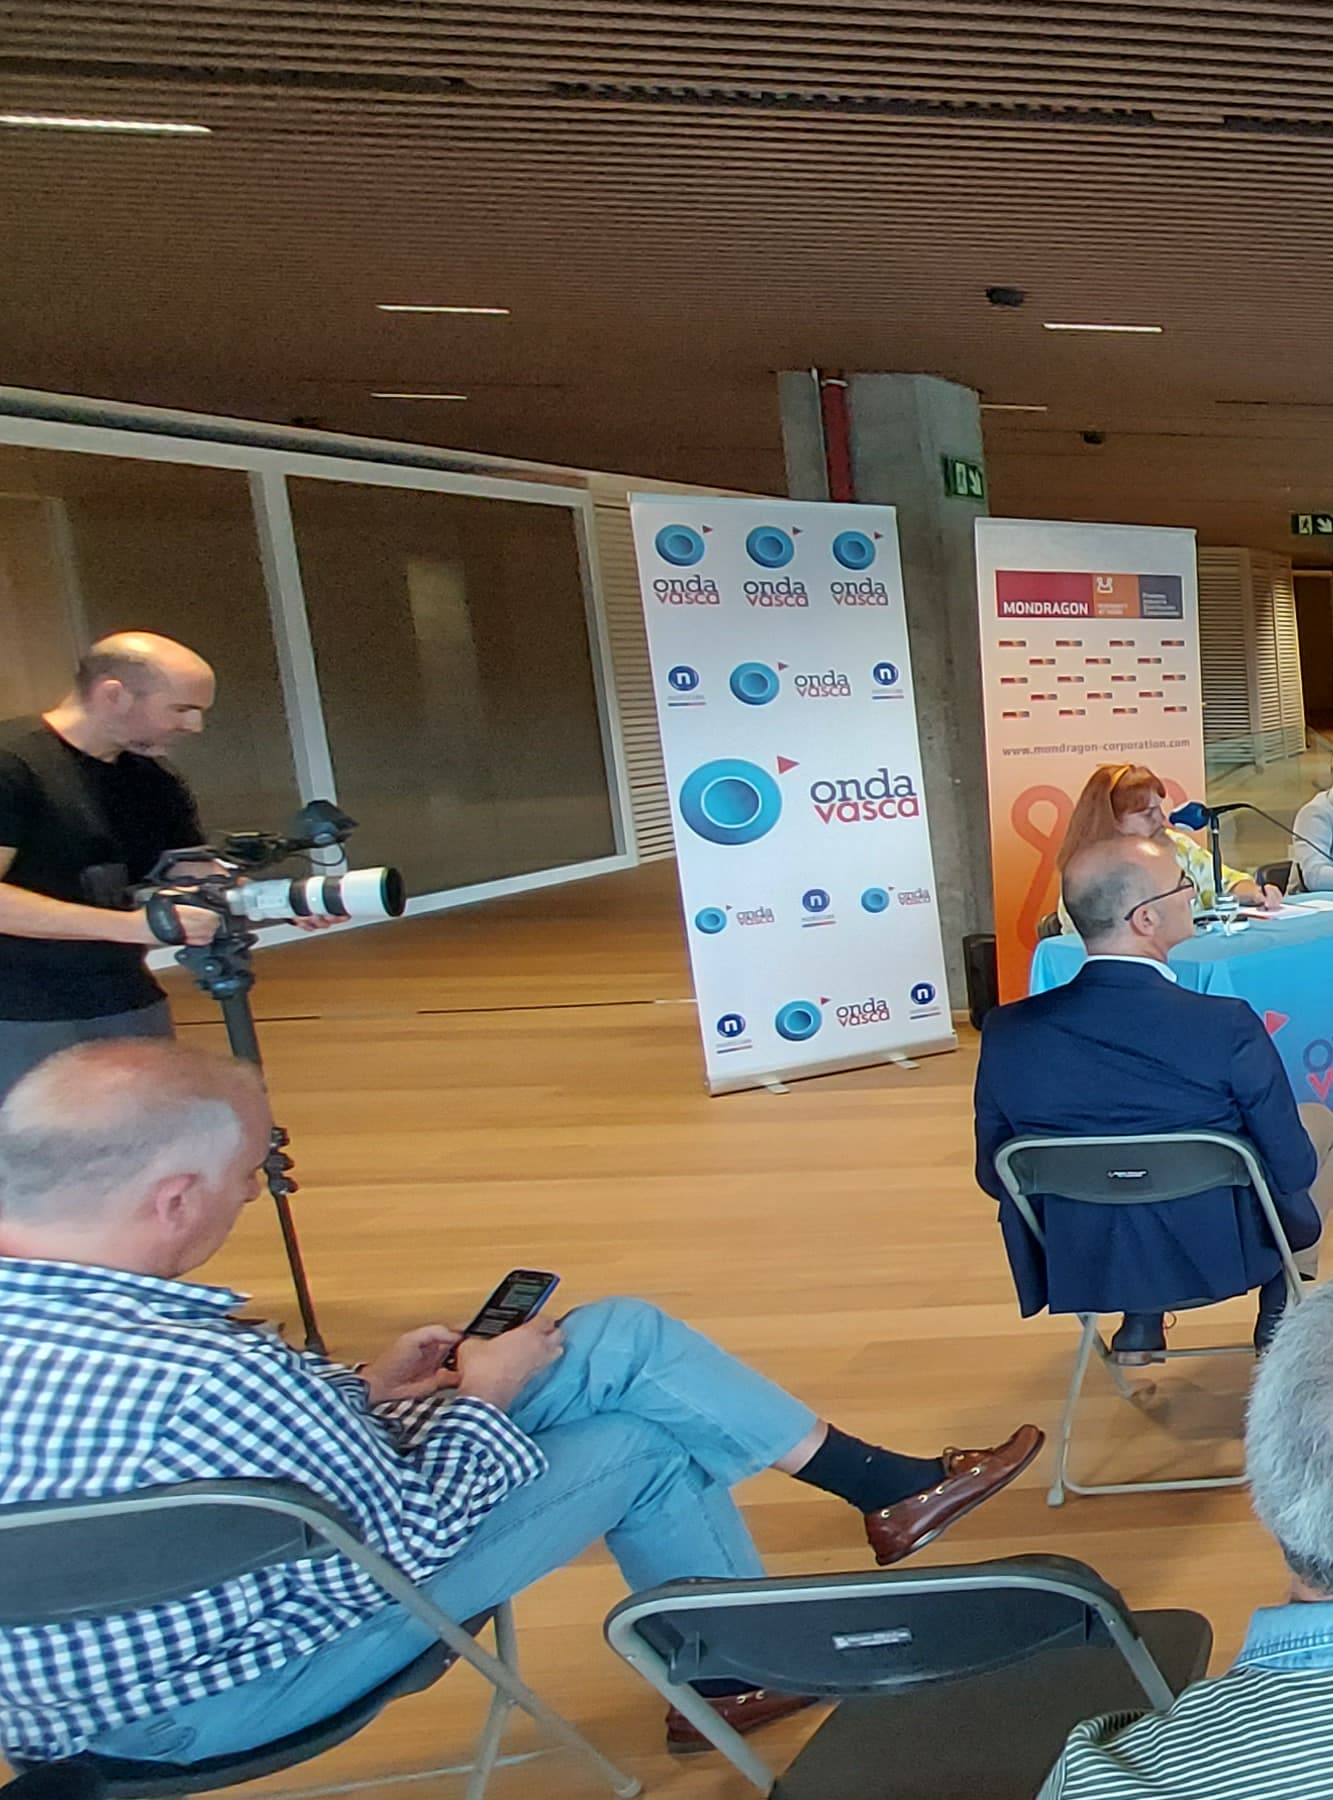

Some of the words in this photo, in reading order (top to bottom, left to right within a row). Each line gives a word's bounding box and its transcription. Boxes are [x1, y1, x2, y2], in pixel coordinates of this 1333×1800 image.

[653, 575, 717, 593] onda
[743, 577, 806, 595] onda
[830, 578, 886, 595] onda
[656, 591, 721, 605] vasca
[745, 592, 809, 607] vasca
[832, 592, 888, 606] vasca
[1003, 600, 1089, 616] MONDRAGON
[795, 670, 849, 688] onda
[797, 685, 851, 697] vasca
[1002, 739, 1190, 757] www.mondragon-corporation.com
[810, 768, 917, 804] onda
[813, 796, 919, 825] vasca
[836, 997, 889, 1020] onda
[838, 1009, 891, 1028] vasca
